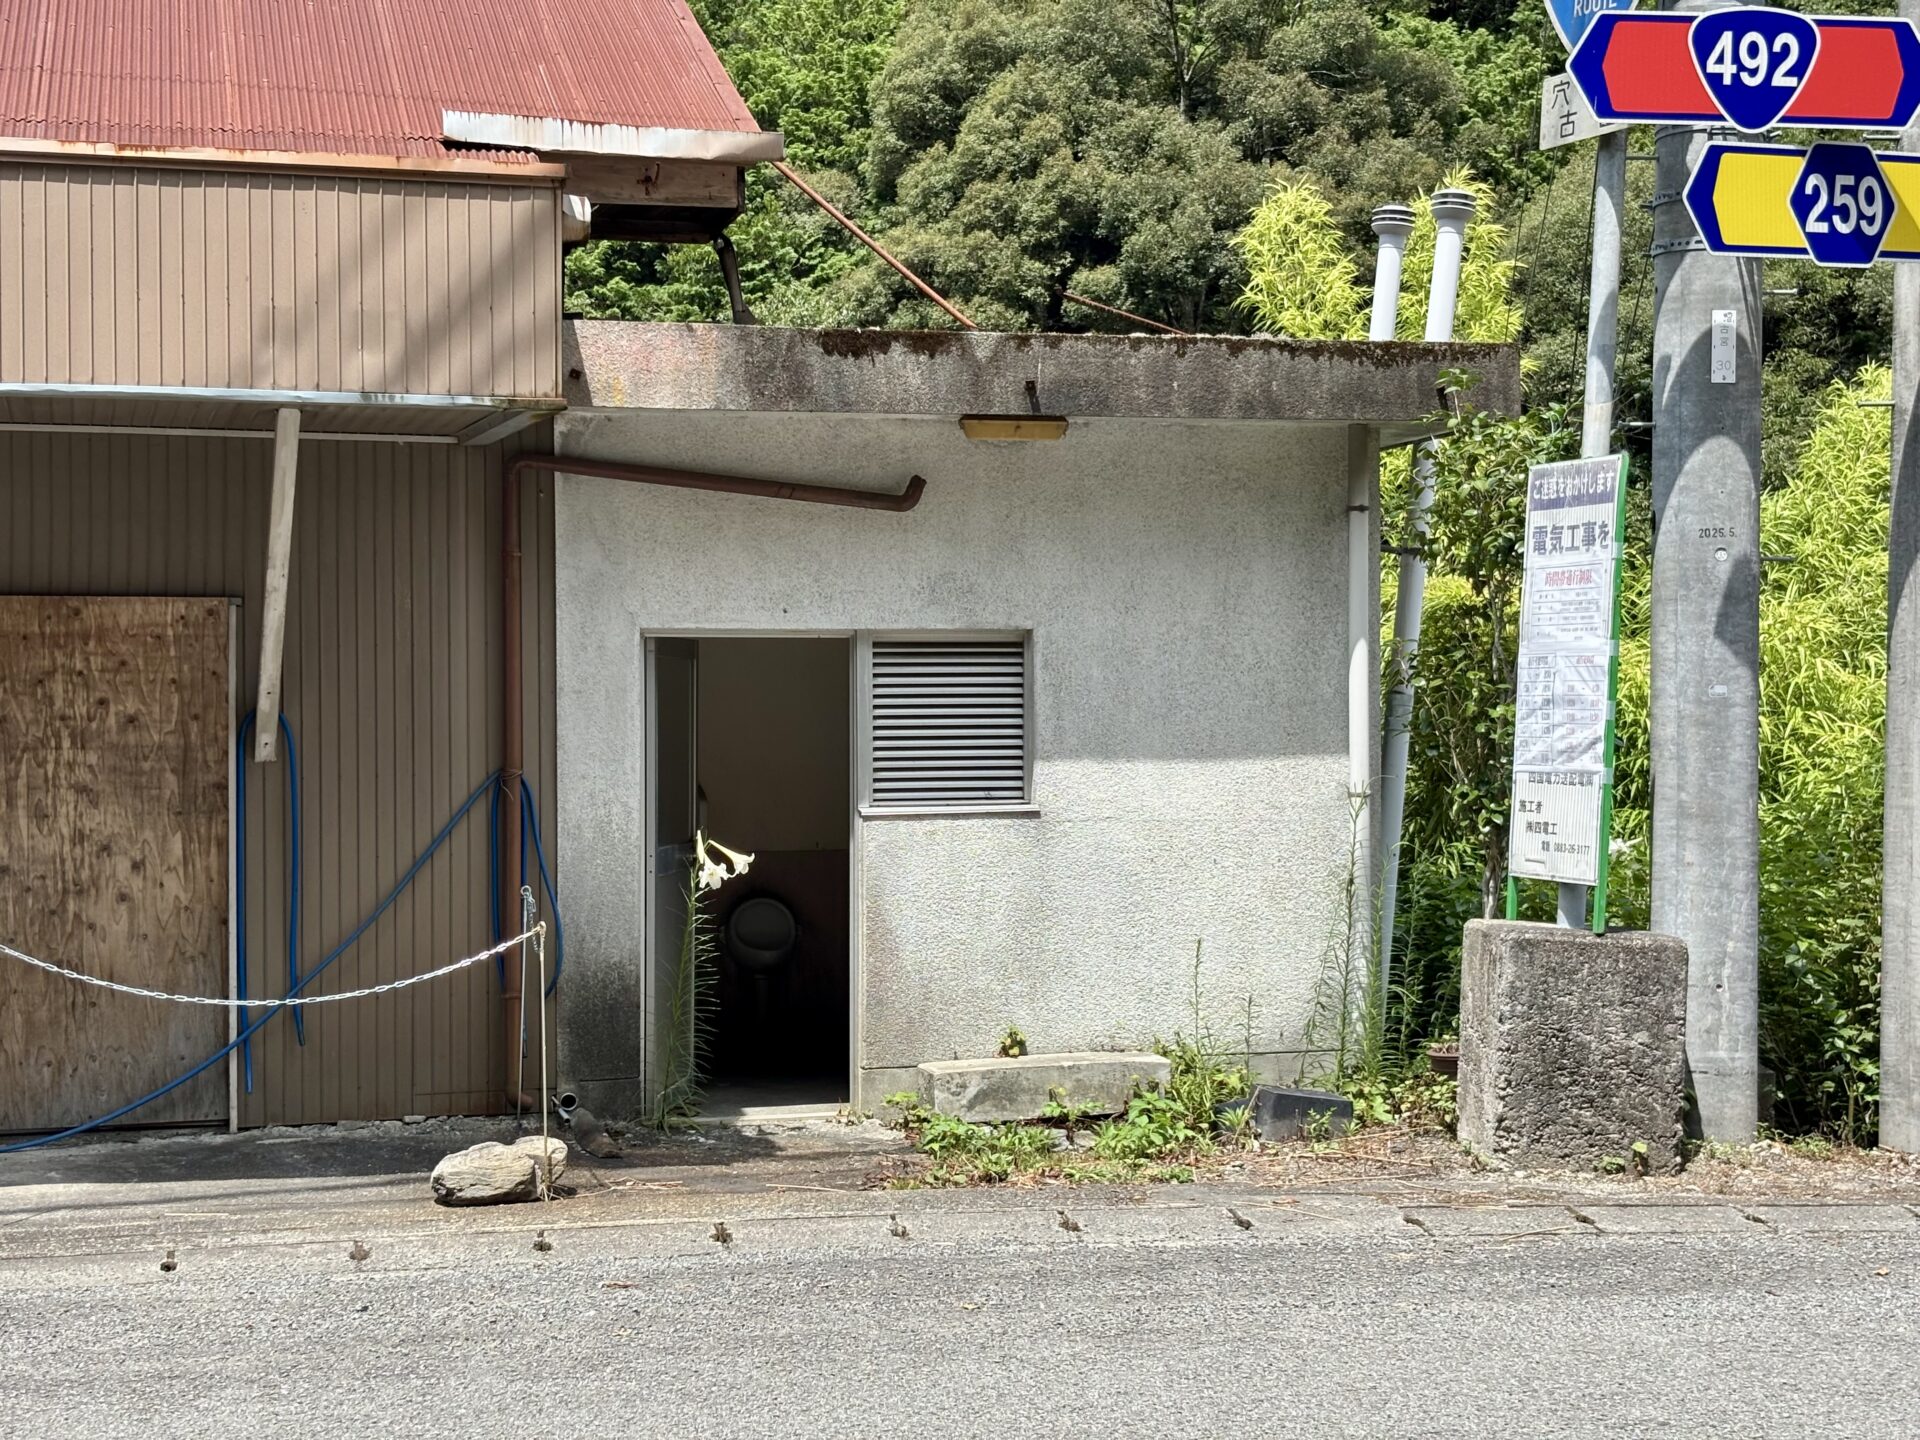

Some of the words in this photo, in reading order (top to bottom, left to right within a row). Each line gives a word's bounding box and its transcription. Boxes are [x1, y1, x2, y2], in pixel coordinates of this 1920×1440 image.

[1706, 31, 1799, 87] 492
[1804, 173, 1883, 236] 259
[1715, 360, 1731, 371] 30
[1533, 469, 1615, 499] ご迷惑をおかけします
[1532, 520, 1610, 555] 電気工事を
[1518, 799, 1543, 814] 施工者
